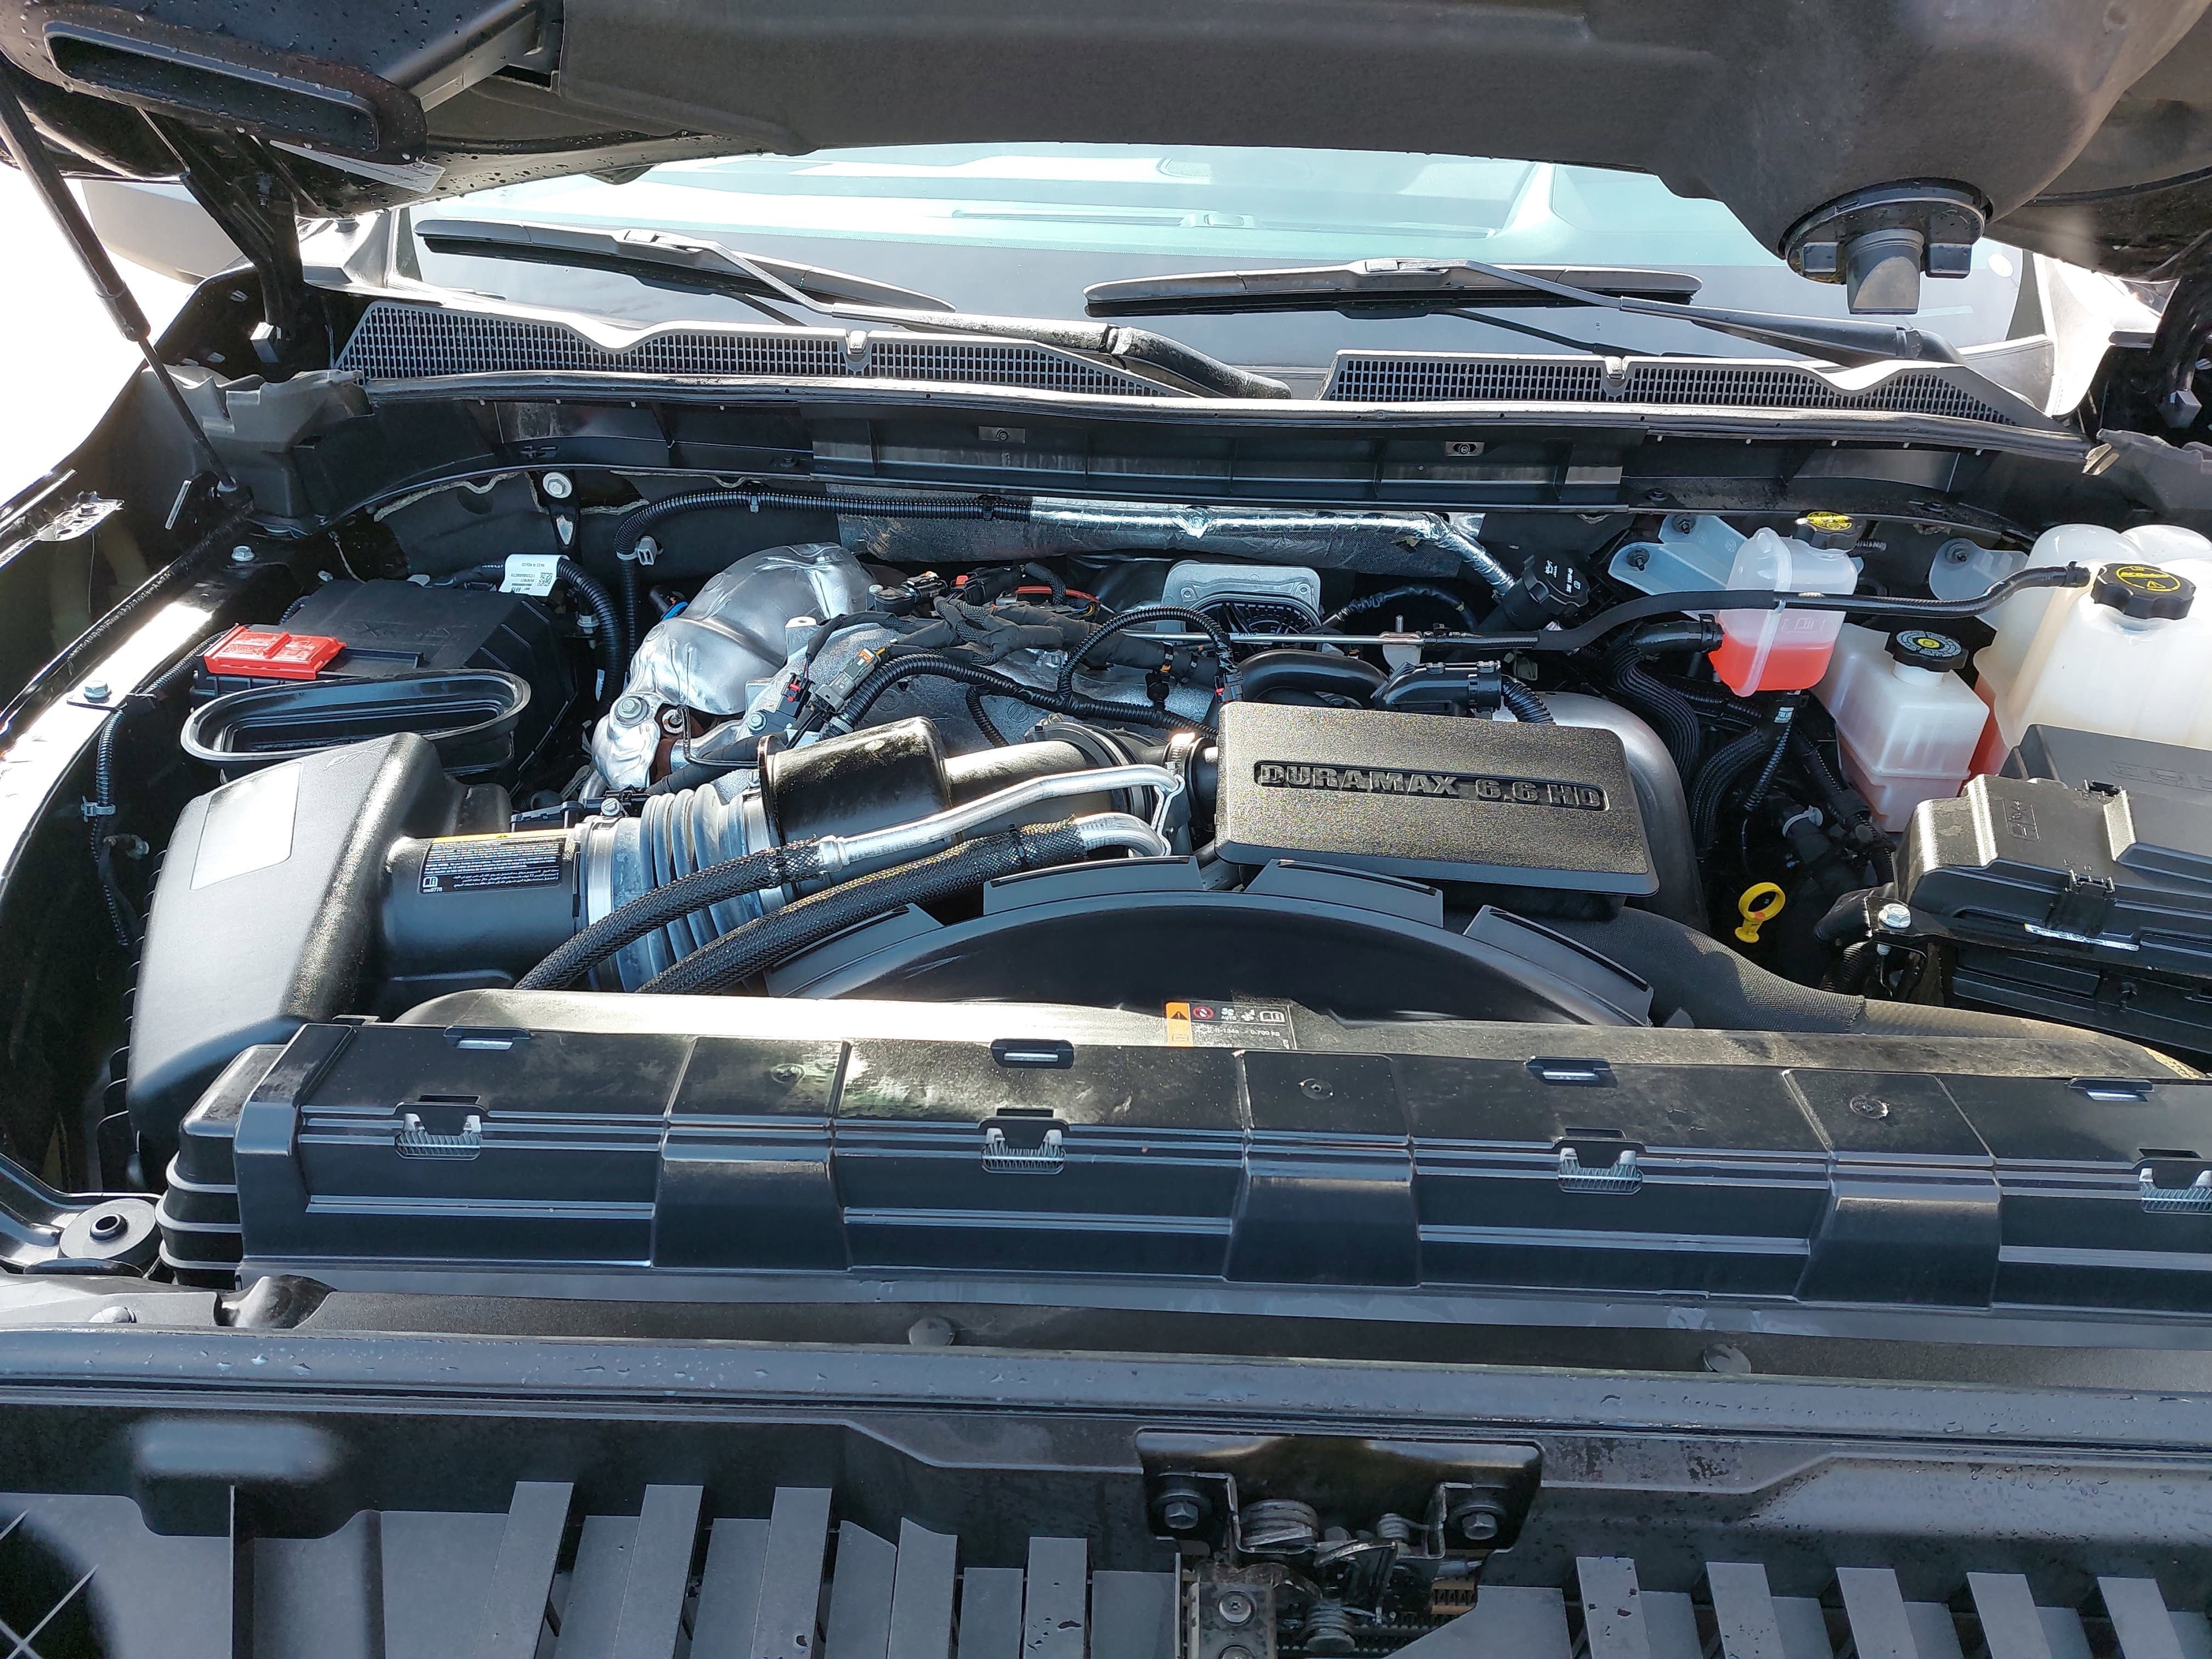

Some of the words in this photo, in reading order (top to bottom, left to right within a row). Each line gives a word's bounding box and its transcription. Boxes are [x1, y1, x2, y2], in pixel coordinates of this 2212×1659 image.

[1260, 764, 1459, 797] DURAMAX
[1476, 779, 1538, 802] 6.6
[1547, 785, 1603, 808] HD
